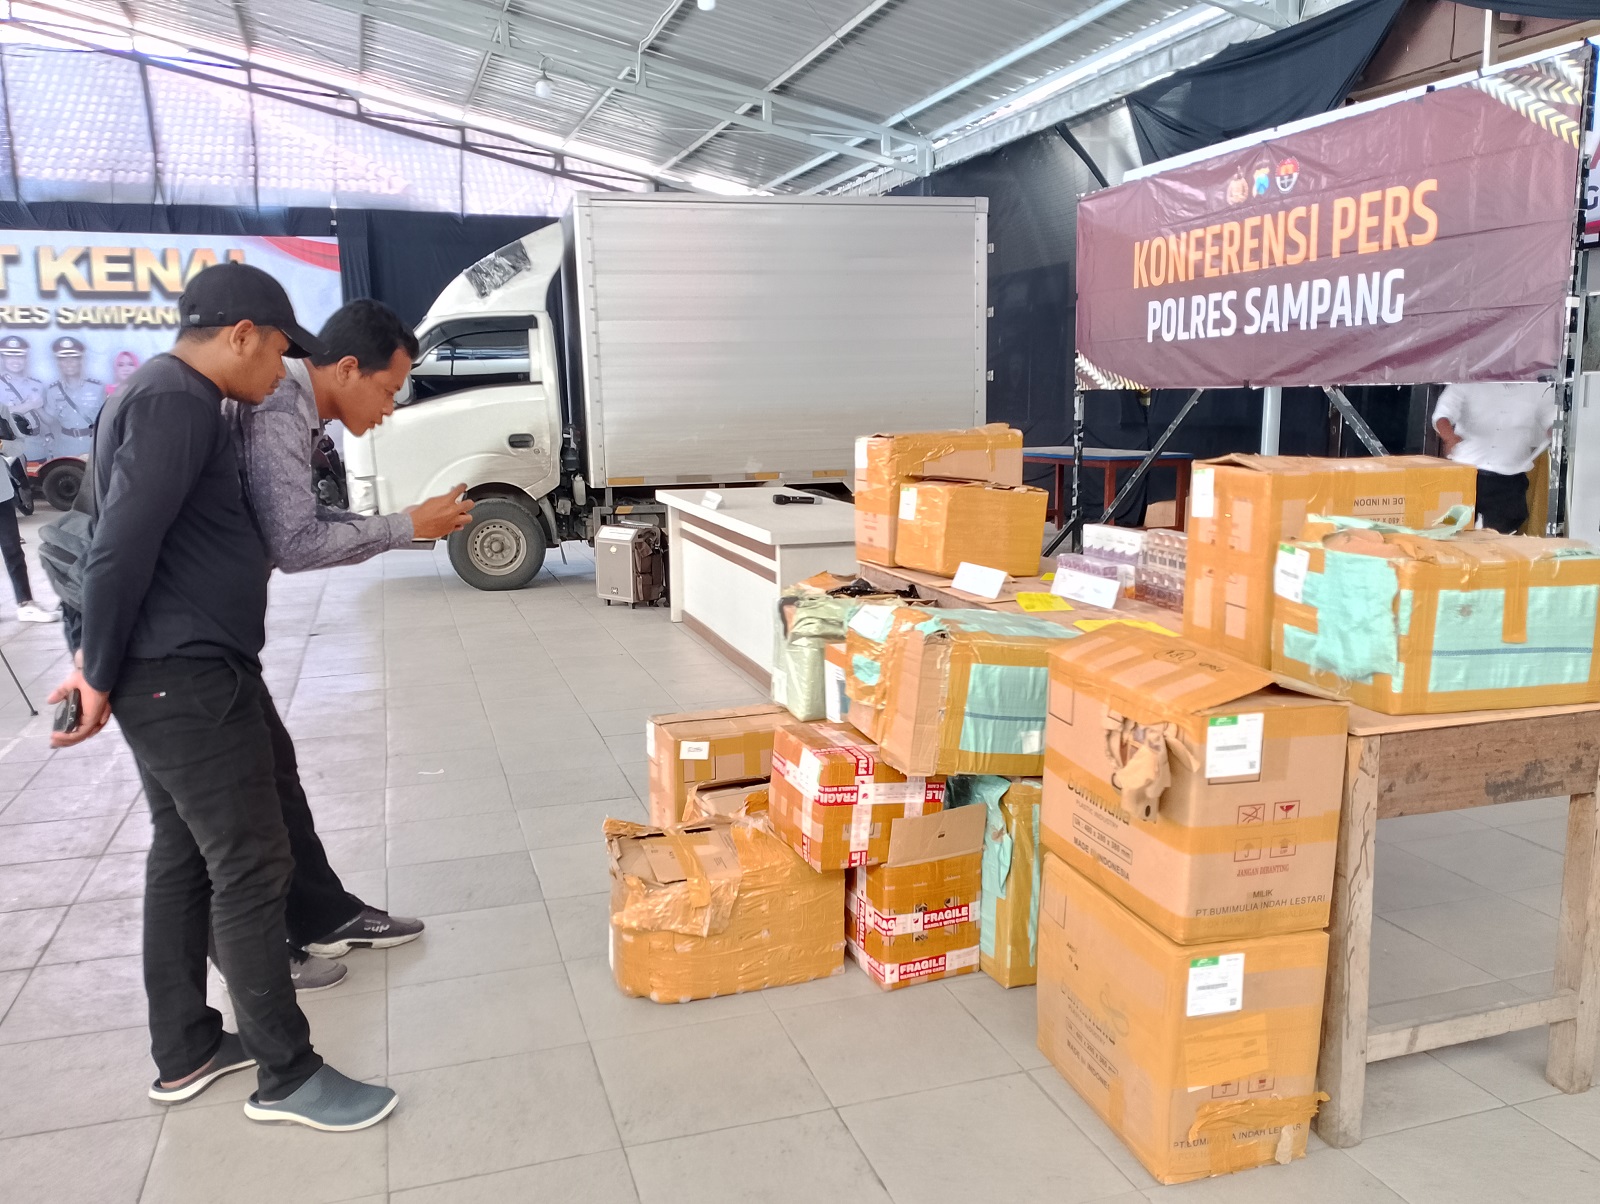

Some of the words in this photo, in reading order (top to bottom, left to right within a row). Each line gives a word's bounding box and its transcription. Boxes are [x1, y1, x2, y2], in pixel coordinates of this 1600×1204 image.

[1133, 203, 1319, 289] KONFERENSI
[1331, 178, 1438, 259] PERS
[37, 246, 246, 294] KENA
[1147, 290, 1237, 343] POLRES
[1244, 268, 1405, 335] SAMPANG
[1353, 498, 1380, 507] INDON
[1382, 498, 1390, 506] IN
[1236, 867, 1259, 877] JANGAN
[1252, 889, 1274, 899] MILIK
[1195, 902, 1259, 917] PT.BUMIMULIA
[1260, 899, 1287, 909] INDAH
[1289, 894, 1326, 906] LESTARI
[874, 914, 896, 930] FRAG
[923, 907, 969, 924] FRAGILE
[899, 957, 946, 975] FRAGILE
[1238, 1127, 1266, 1139] INDAH
